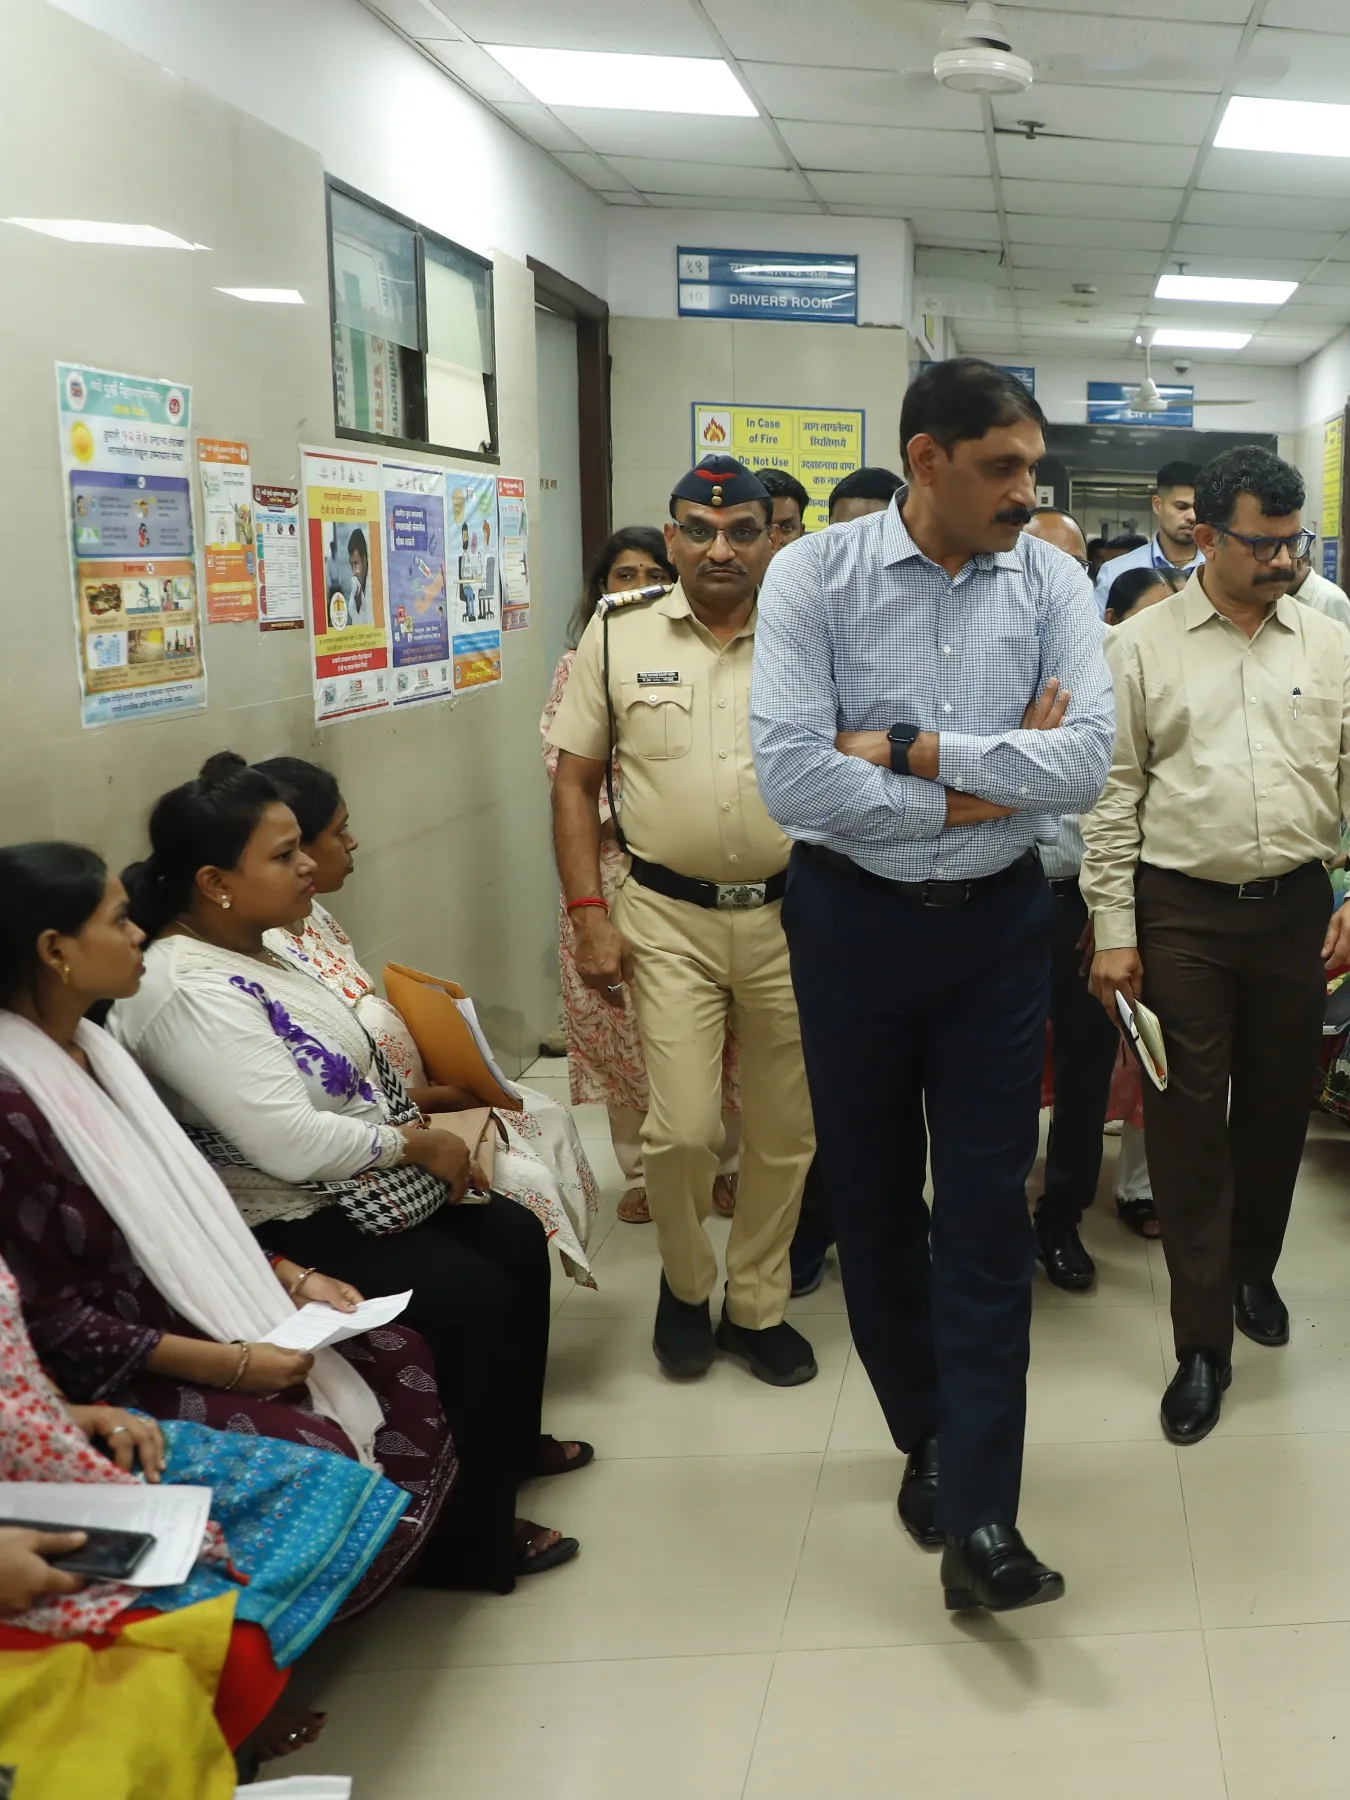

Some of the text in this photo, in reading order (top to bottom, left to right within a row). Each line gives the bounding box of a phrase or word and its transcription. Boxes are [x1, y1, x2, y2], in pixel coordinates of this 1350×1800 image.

[729, 293, 788, 307] DRIVERS
[791, 296, 833, 309] ROOM
[746, 418, 780, 428] In Case
[749, 434, 778, 444] of Fire
[739, 456, 788, 466] Do Not Use
